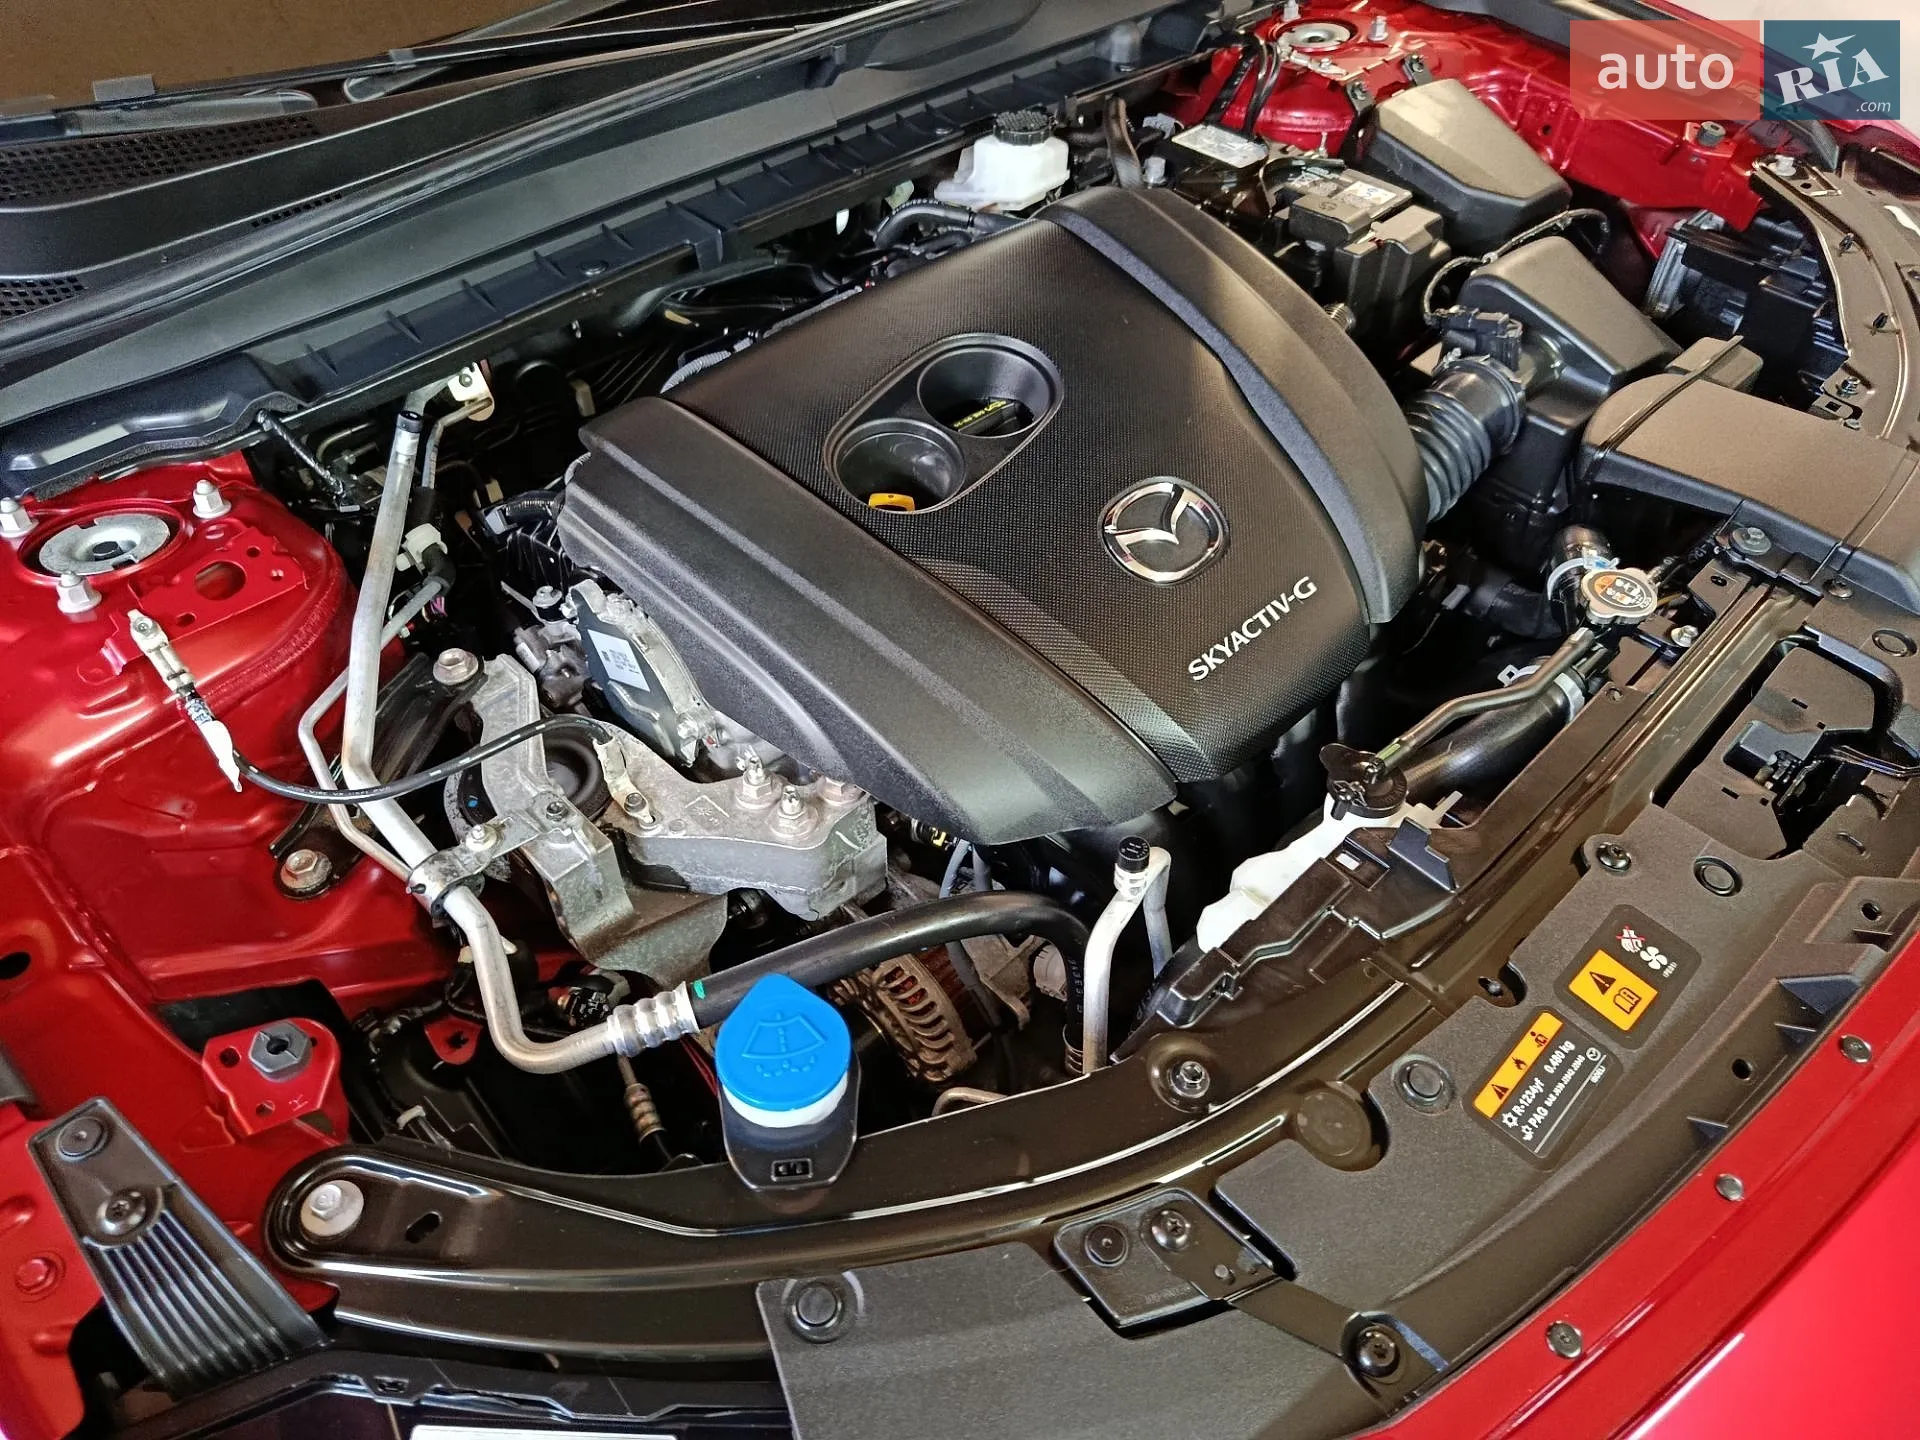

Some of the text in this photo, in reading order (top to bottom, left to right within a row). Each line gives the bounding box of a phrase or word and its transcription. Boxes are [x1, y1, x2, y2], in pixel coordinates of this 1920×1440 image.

[1188, 576, 1317, 681] SKYACTIV-G
[1512, 1077, 1545, 1117] R-1234yf
[1560, 1040, 1576, 1055] kg
[1527, 1106, 1549, 1129] PAG
